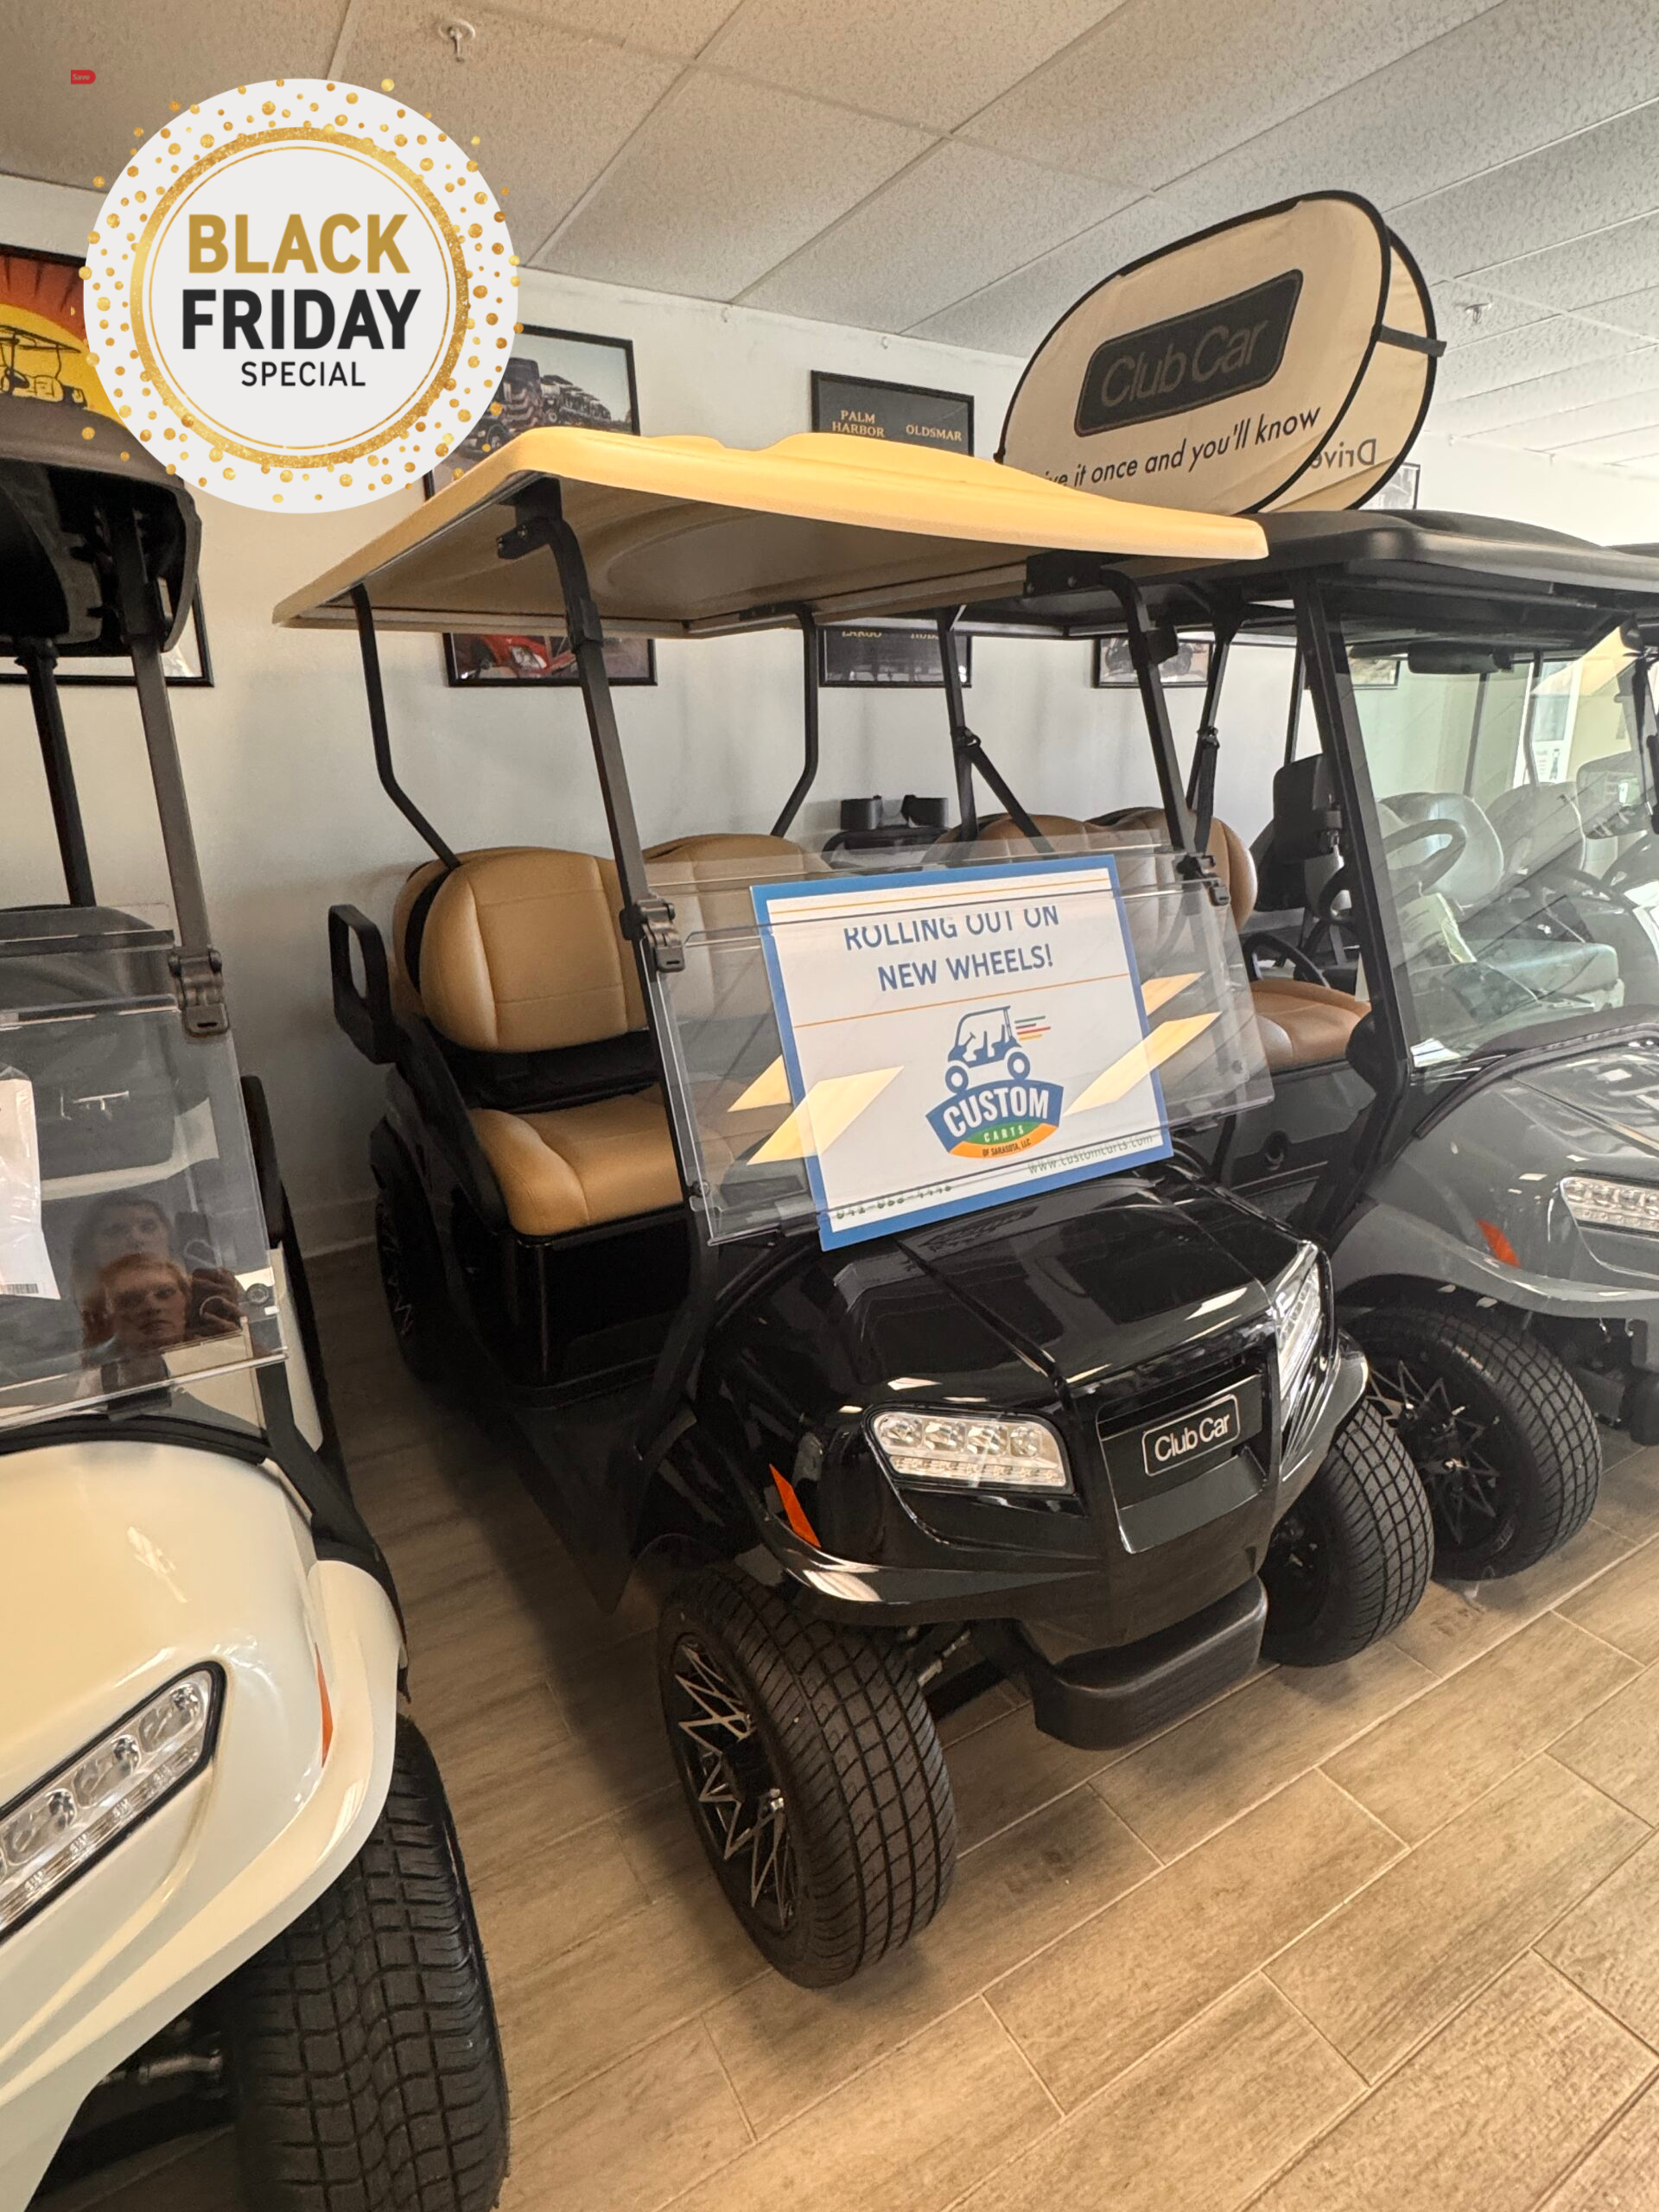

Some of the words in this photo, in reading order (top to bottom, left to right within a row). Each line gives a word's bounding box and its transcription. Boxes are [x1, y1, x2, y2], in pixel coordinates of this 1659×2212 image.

[1101, 343, 1187, 407] Club
[1192, 321, 1268, 382] Car
[831, 421, 885, 438] HARBOR
[841, 410, 876, 424] PALM
[906, 424, 962, 442] OLDSMAR
[1074, 463, 1086, 487] it
[1091, 459, 1137, 484] once
[1145, 438, 1186, 474] and
[1189, 417, 1251, 473] you'll
[1255, 407, 1321, 445] know
[843, 917, 958, 951] ROLLING
[1023, 905, 1059, 929] ON
[878, 960, 938, 991] NEW
[945, 944, 1053, 981] WHEELS!
[943, 1086, 1049, 1138] CUSTOM
[983, 1125, 1025, 1143] CARTS
[1154, 1427, 1198, 1461] Club
[1199, 1414, 1230, 1442] Car
